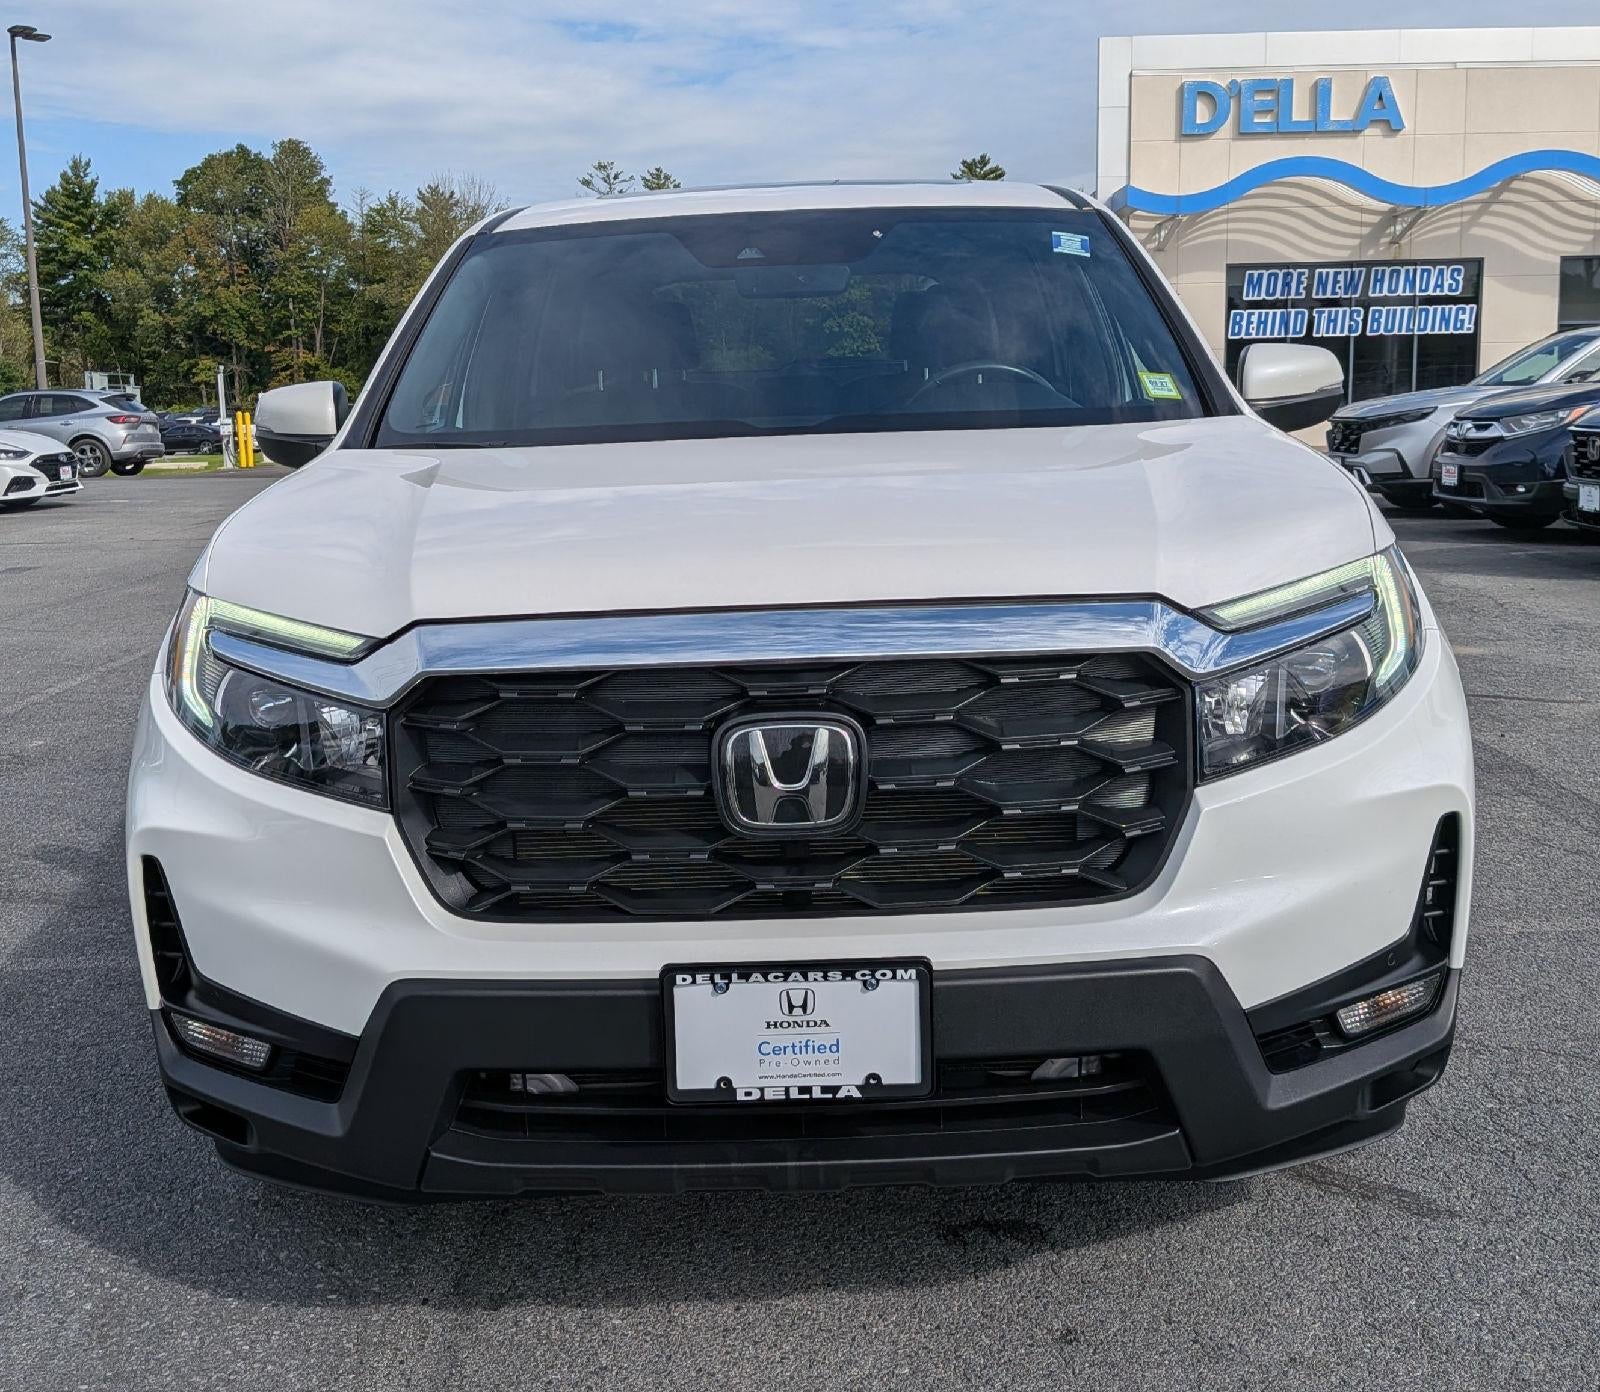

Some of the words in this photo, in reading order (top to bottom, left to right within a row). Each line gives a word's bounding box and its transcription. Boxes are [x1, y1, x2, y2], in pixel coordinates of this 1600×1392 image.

[1181, 76, 1405, 135] D'ELLA
[1243, 269, 1307, 300] MORE
[1313, 267, 1366, 298] NEW
[1369, 265, 1464, 296] HONDAS
[1228, 307, 1308, 339] BEHIND
[1313, 306, 1363, 337] THIS
[1367, 303, 1477, 336] BUILDING!
[675, 969, 917, 985] DELLACARS.COM
[765, 1019, 831, 1030] HONDA
[757, 1038, 840, 1056] Certified
[759, 1057, 840, 1068] Pre-Owned
[736, 1085, 862, 1101] DELLA
